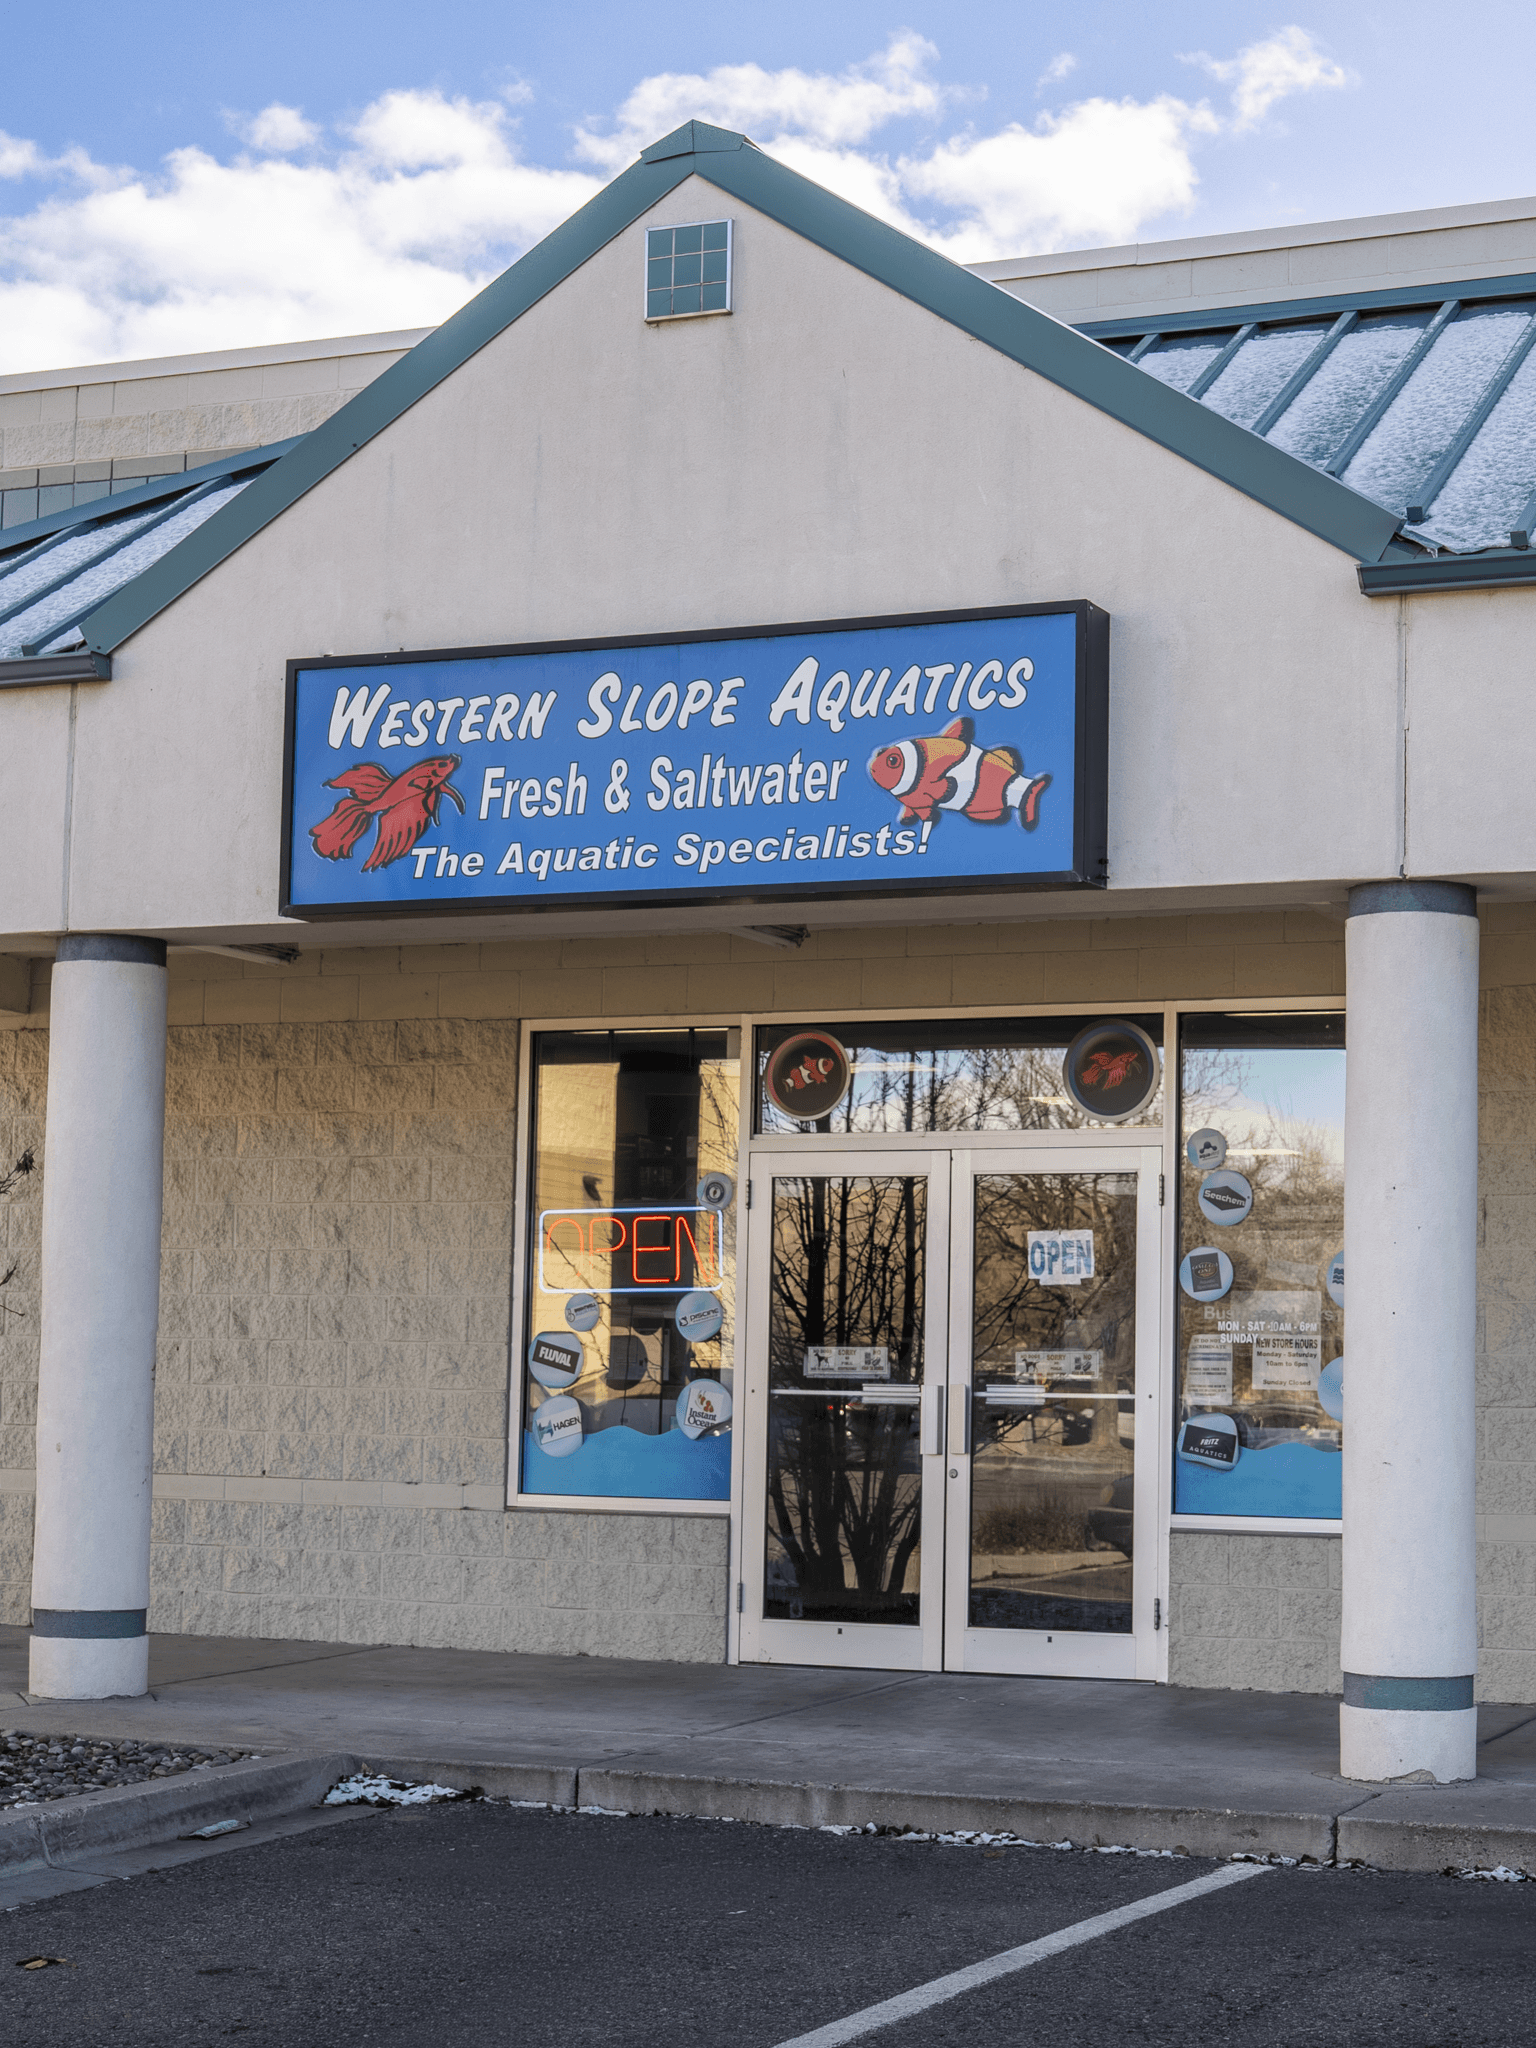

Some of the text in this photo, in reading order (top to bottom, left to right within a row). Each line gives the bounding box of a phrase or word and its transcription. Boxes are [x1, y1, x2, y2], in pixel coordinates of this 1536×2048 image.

[327, 655, 1035, 750] WESTERN SLOPE AQUATICS
[478, 750, 849, 821] Fresh & Saltwater
[410, 821, 934, 882] The Aquatic Specialists!
[1204, 1189, 1246, 1207] Seachem
[545, 1215, 715, 1284] OPEN
[1030, 1240, 1092, 1276] OPEN
[1217, 1321, 1240, 1332] MON
[1247, 1321, 1266, 1332] SAT
[1299, 1320, 1318, 1332] 6PM
[1220, 1333, 1259, 1344] SUNDAY
[1256, 1337, 1318, 1349] NEW STORE HOURS
[538, 1345, 572, 1367] FLUVAL
[1287, 1351, 1318, 1359] Saturday
[1262, 1379, 1287, 1387] Sunday
[689, 1407, 718, 1421] Instant
[553, 1416, 582, 1432] HAGEN
[1199, 1438, 1220, 1446] FRITZ
[1188, 1446, 1228, 1459] AQUATICS
